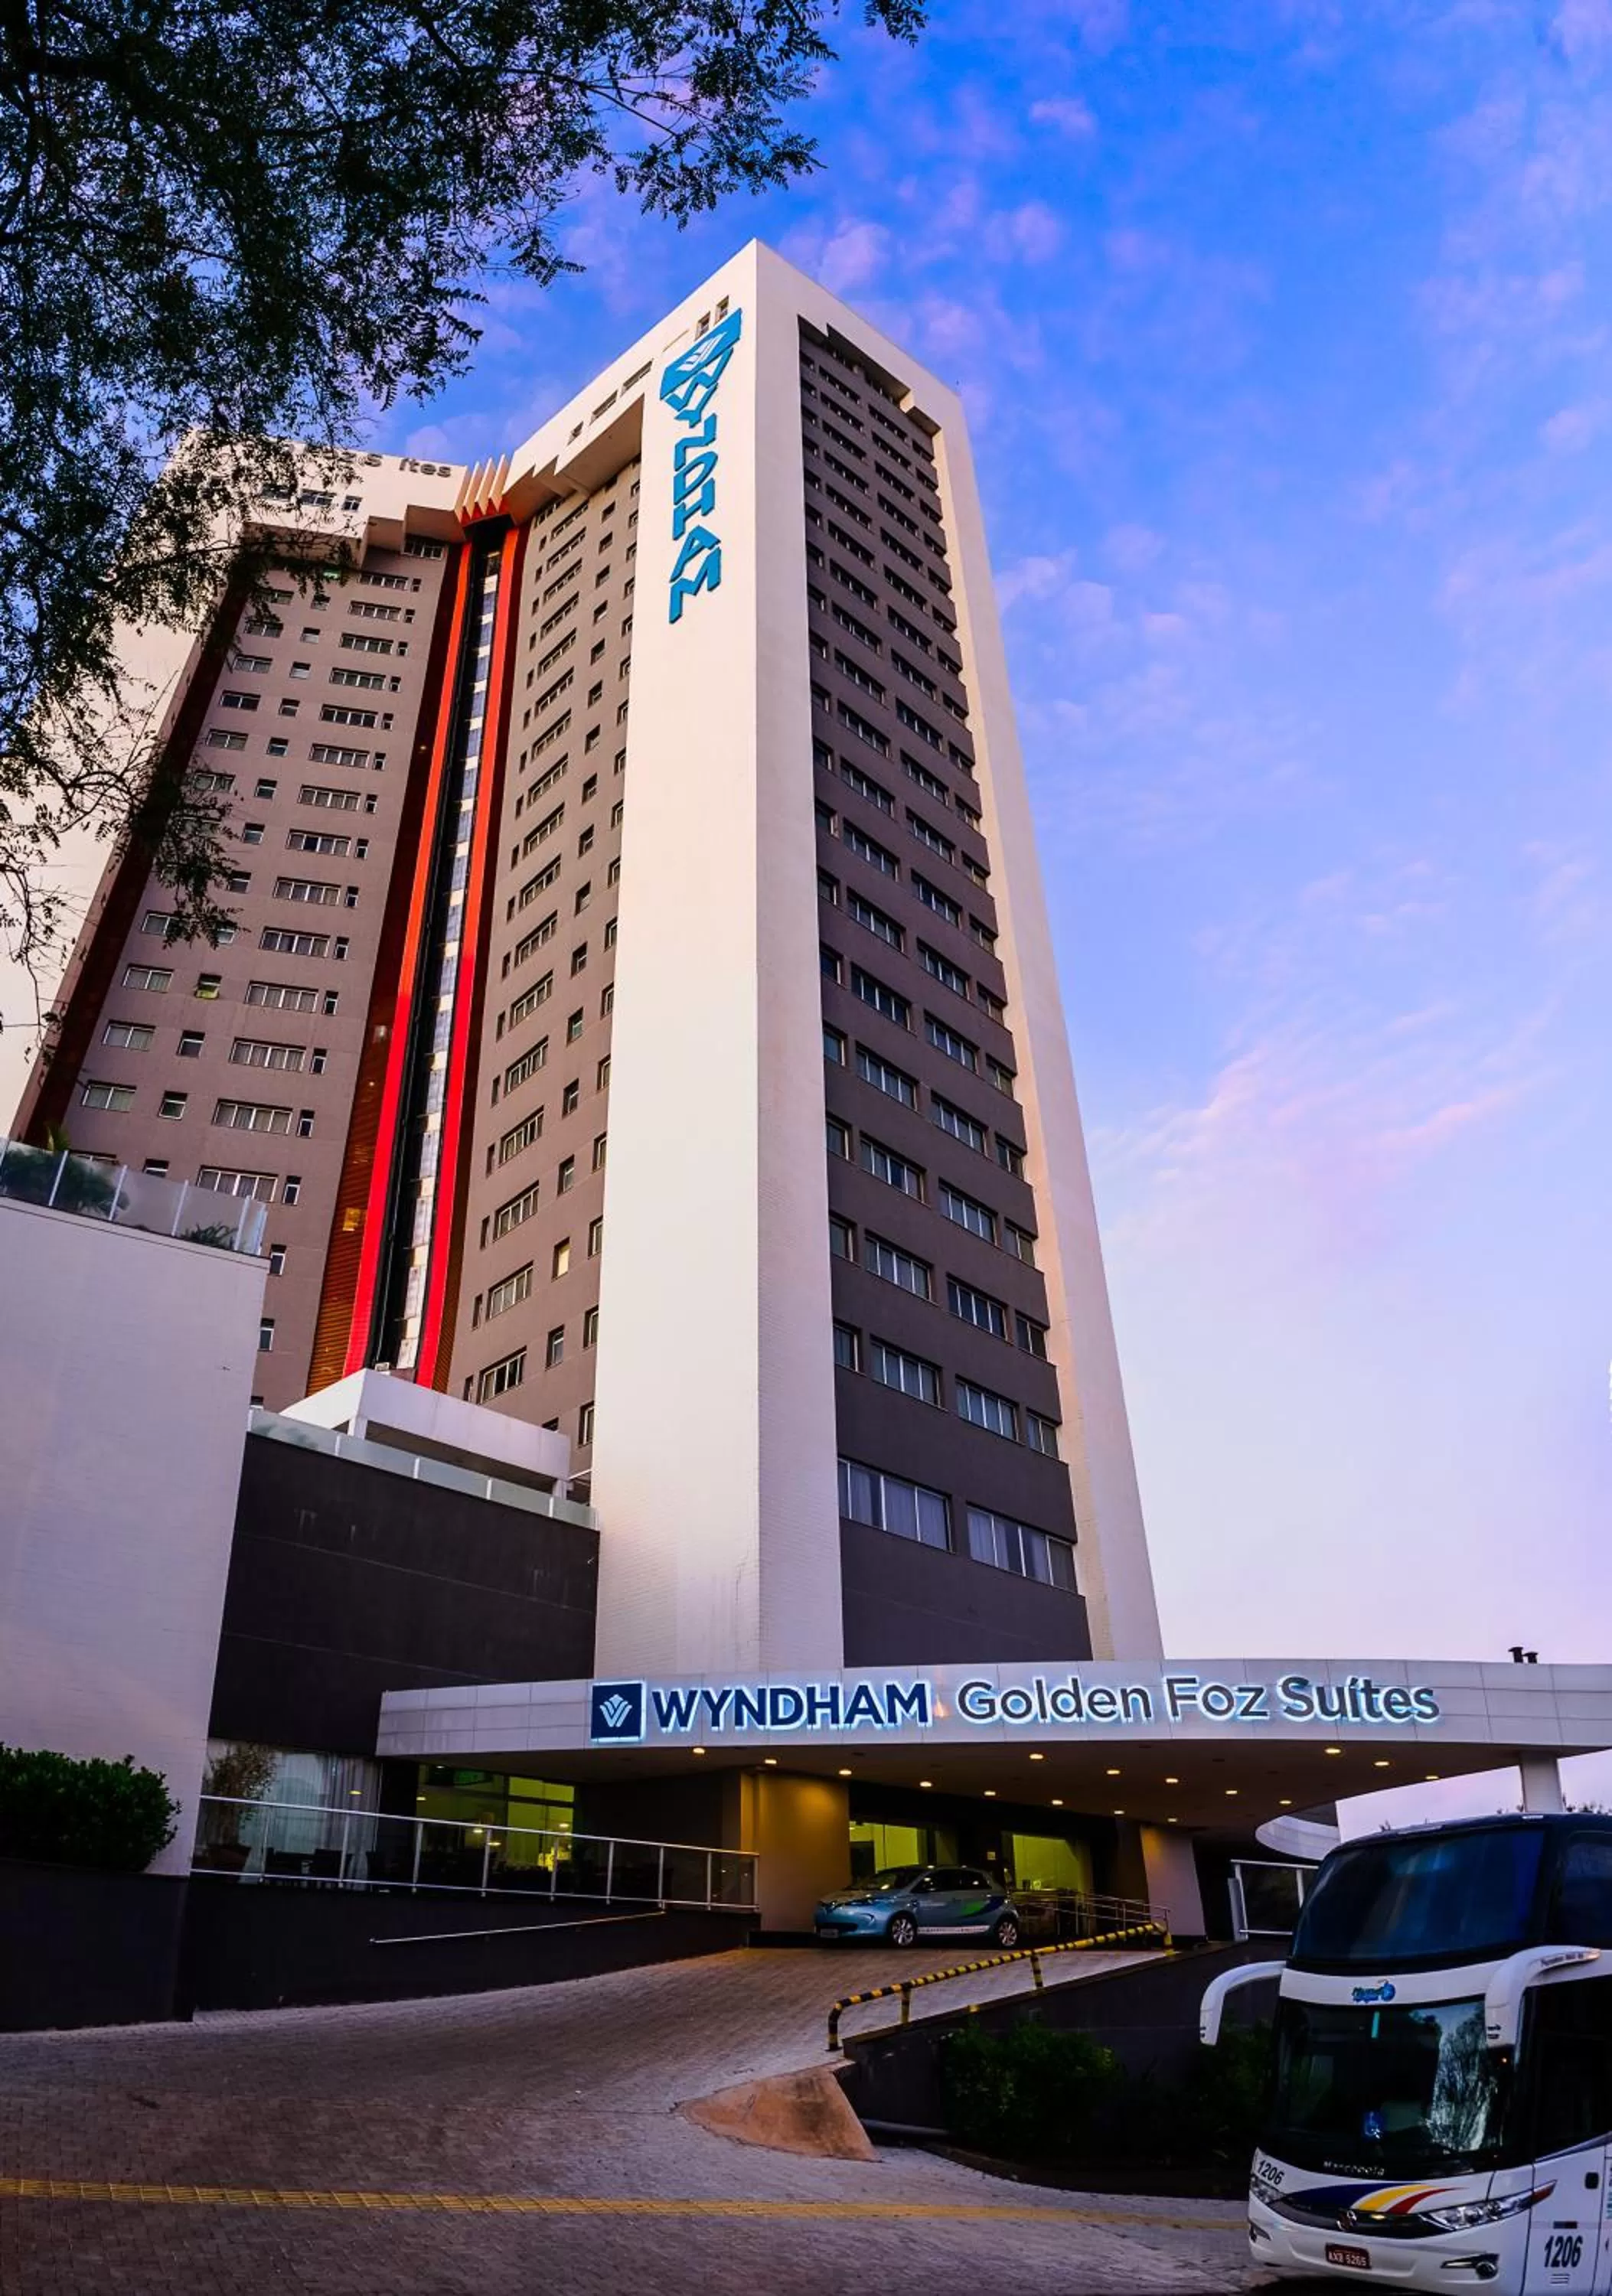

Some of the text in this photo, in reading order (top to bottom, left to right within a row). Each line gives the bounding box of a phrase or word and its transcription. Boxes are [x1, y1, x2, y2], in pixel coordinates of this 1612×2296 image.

[666, 347, 734, 625] WYNDHAM
[651, 1682, 930, 1730] WYNDHAM
[956, 1676, 1154, 1721] Golden
[1164, 1675, 1268, 1719] Foz
[1257, 2159, 1285, 2186] 1206
[1544, 2235, 1584, 2268] 1206
